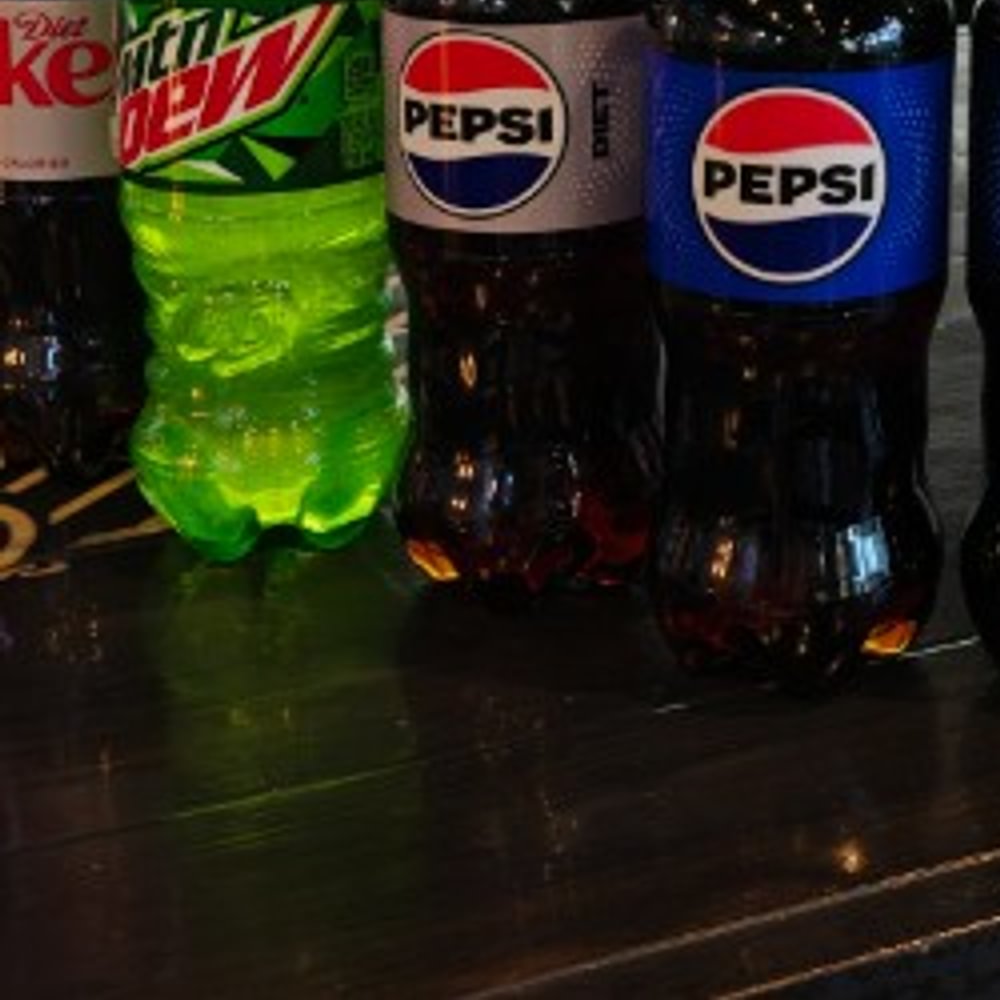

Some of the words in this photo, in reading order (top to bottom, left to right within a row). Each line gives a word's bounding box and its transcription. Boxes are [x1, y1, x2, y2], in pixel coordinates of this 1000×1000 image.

[14, 12, 89, 40] Diet
[0, 17, 115, 108] ke
[404, 100, 554, 145] PEPSI
[592, 80, 609, 159] DIET
[703, 160, 877, 205] PEPSI
